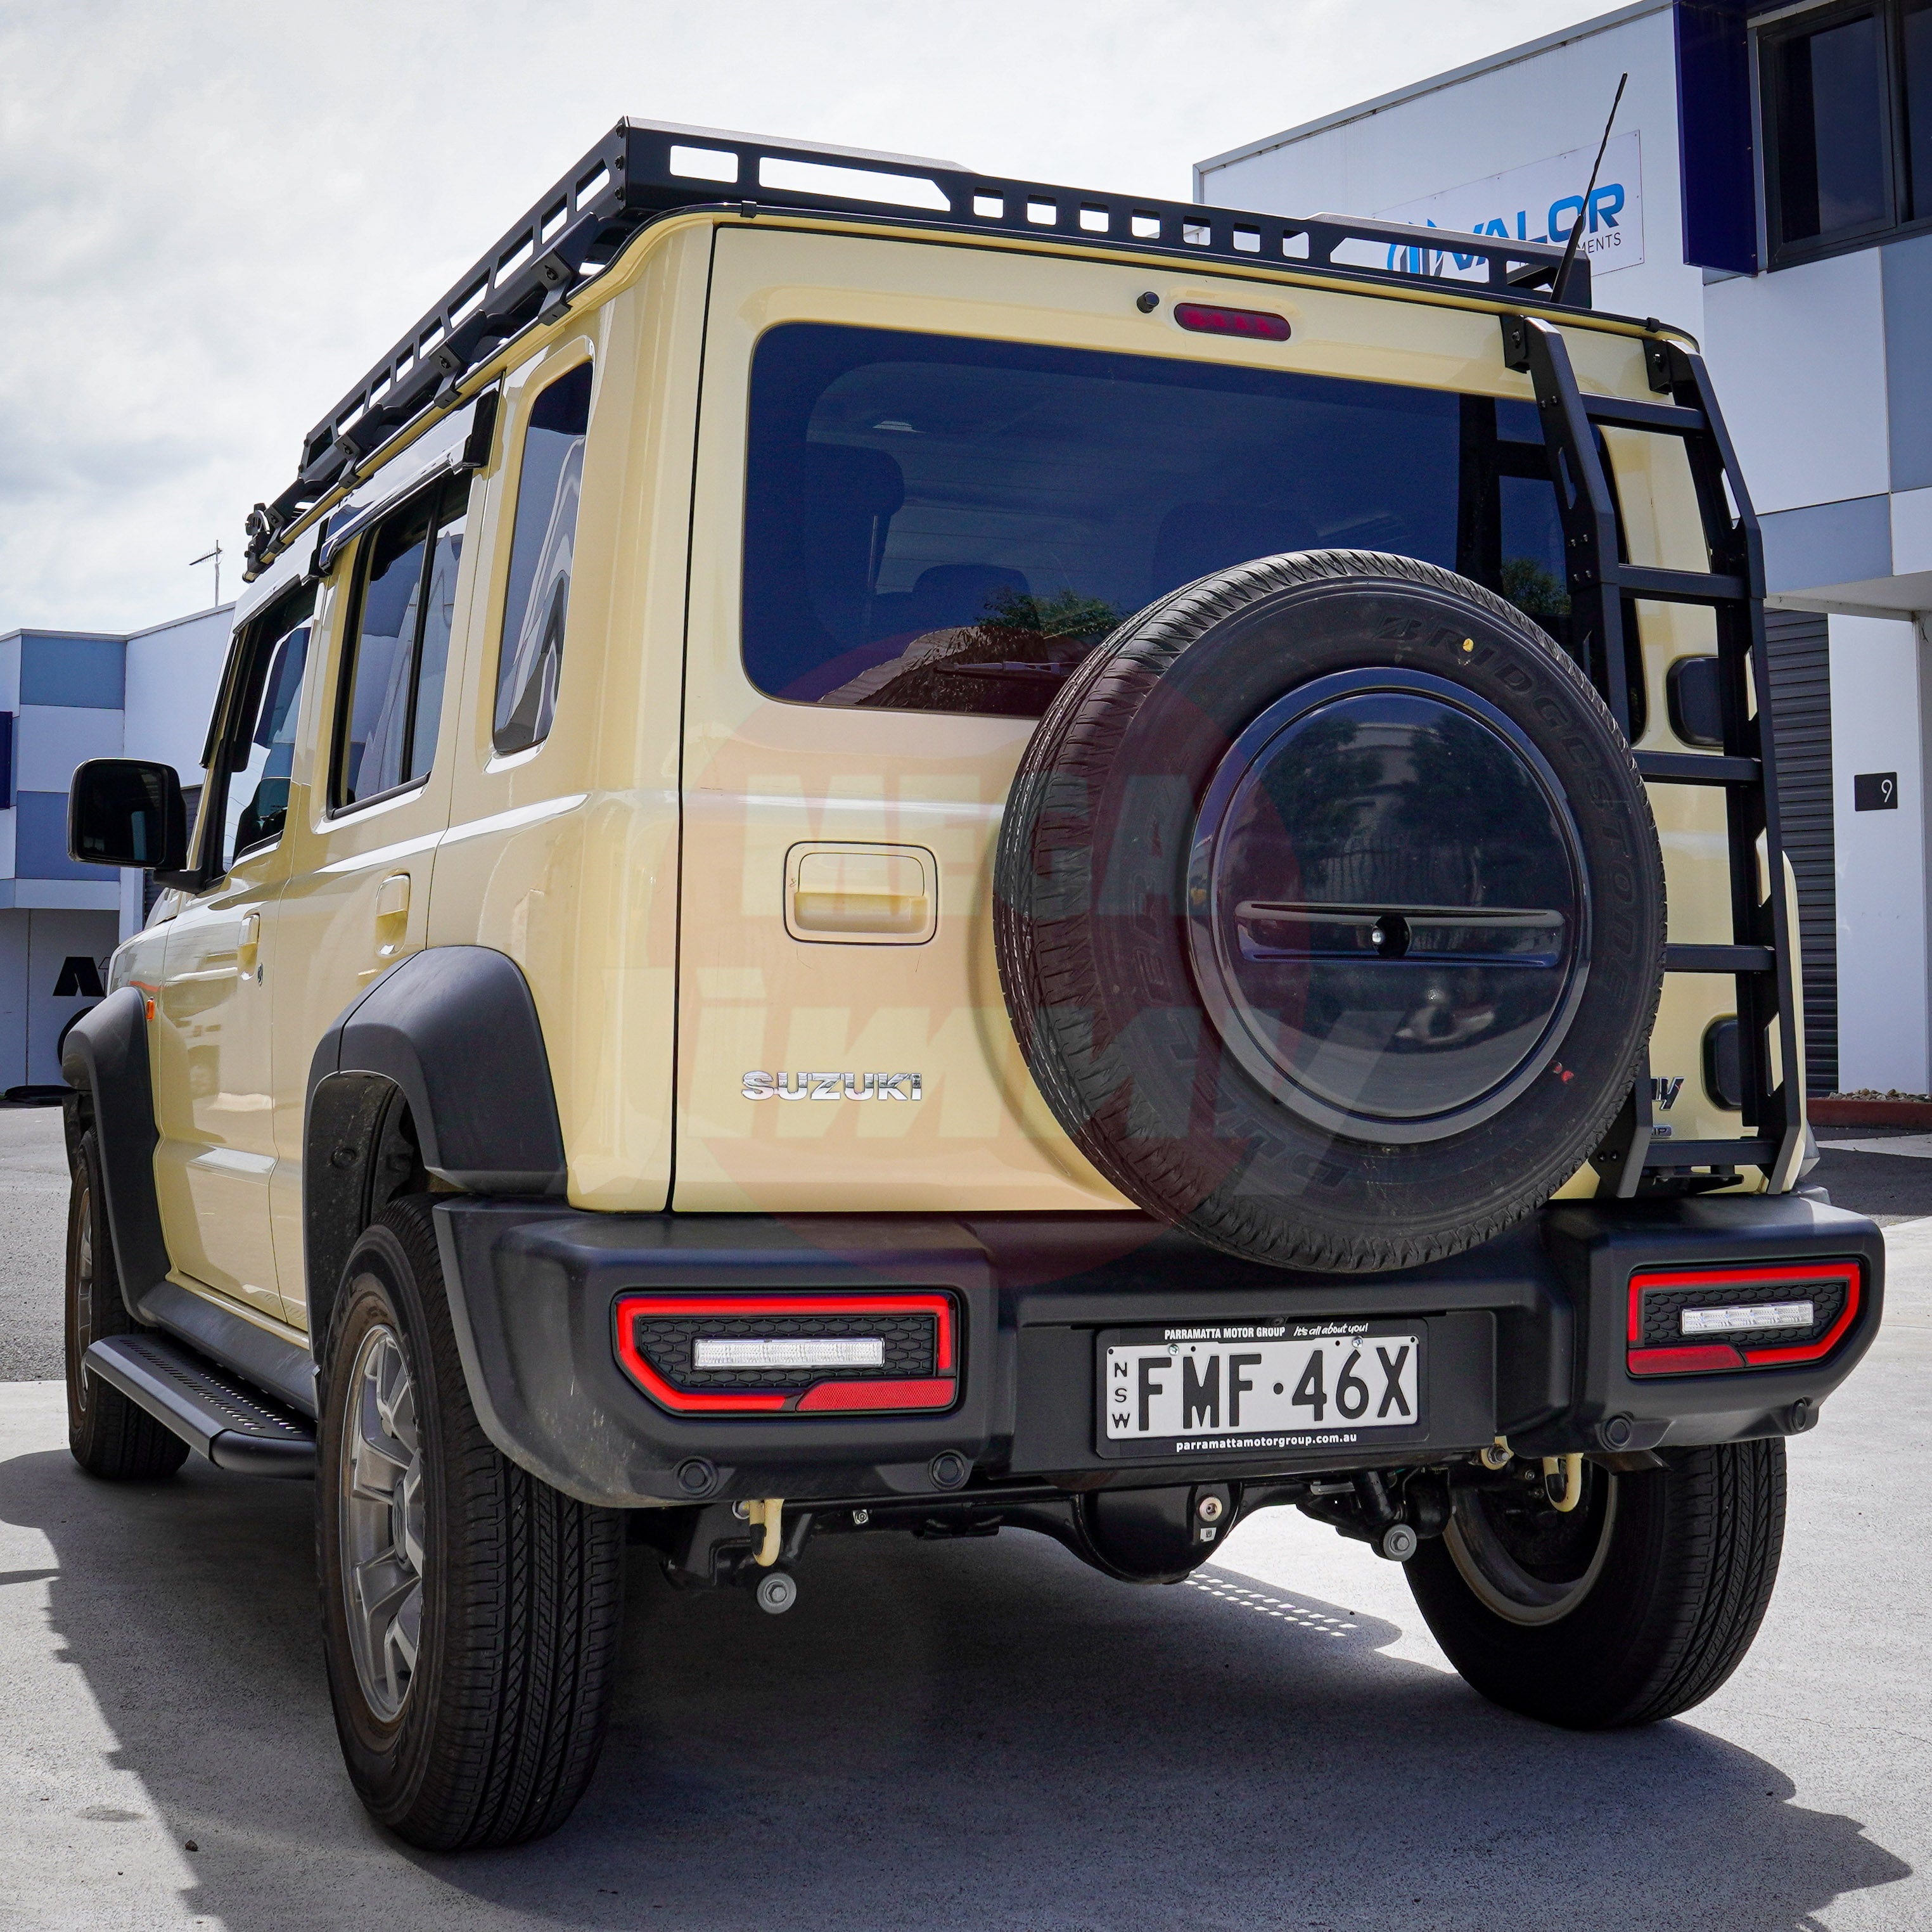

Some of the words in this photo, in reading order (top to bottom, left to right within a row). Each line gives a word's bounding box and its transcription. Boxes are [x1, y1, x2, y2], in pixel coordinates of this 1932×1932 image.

[1881, 779, 1893, 803] 9
[741, 1070, 923, 1101] SUZUKI
[1164, 1328, 1221, 1340] PARRAMATTA
[1223, 1327, 1254, 1338] MOTOR
[1256, 1326, 1286, 1337] GROUP
[1321, 1322, 1348, 1334] about
[1176, 1433, 1357, 1452] parramattamotorgroup.com.au
